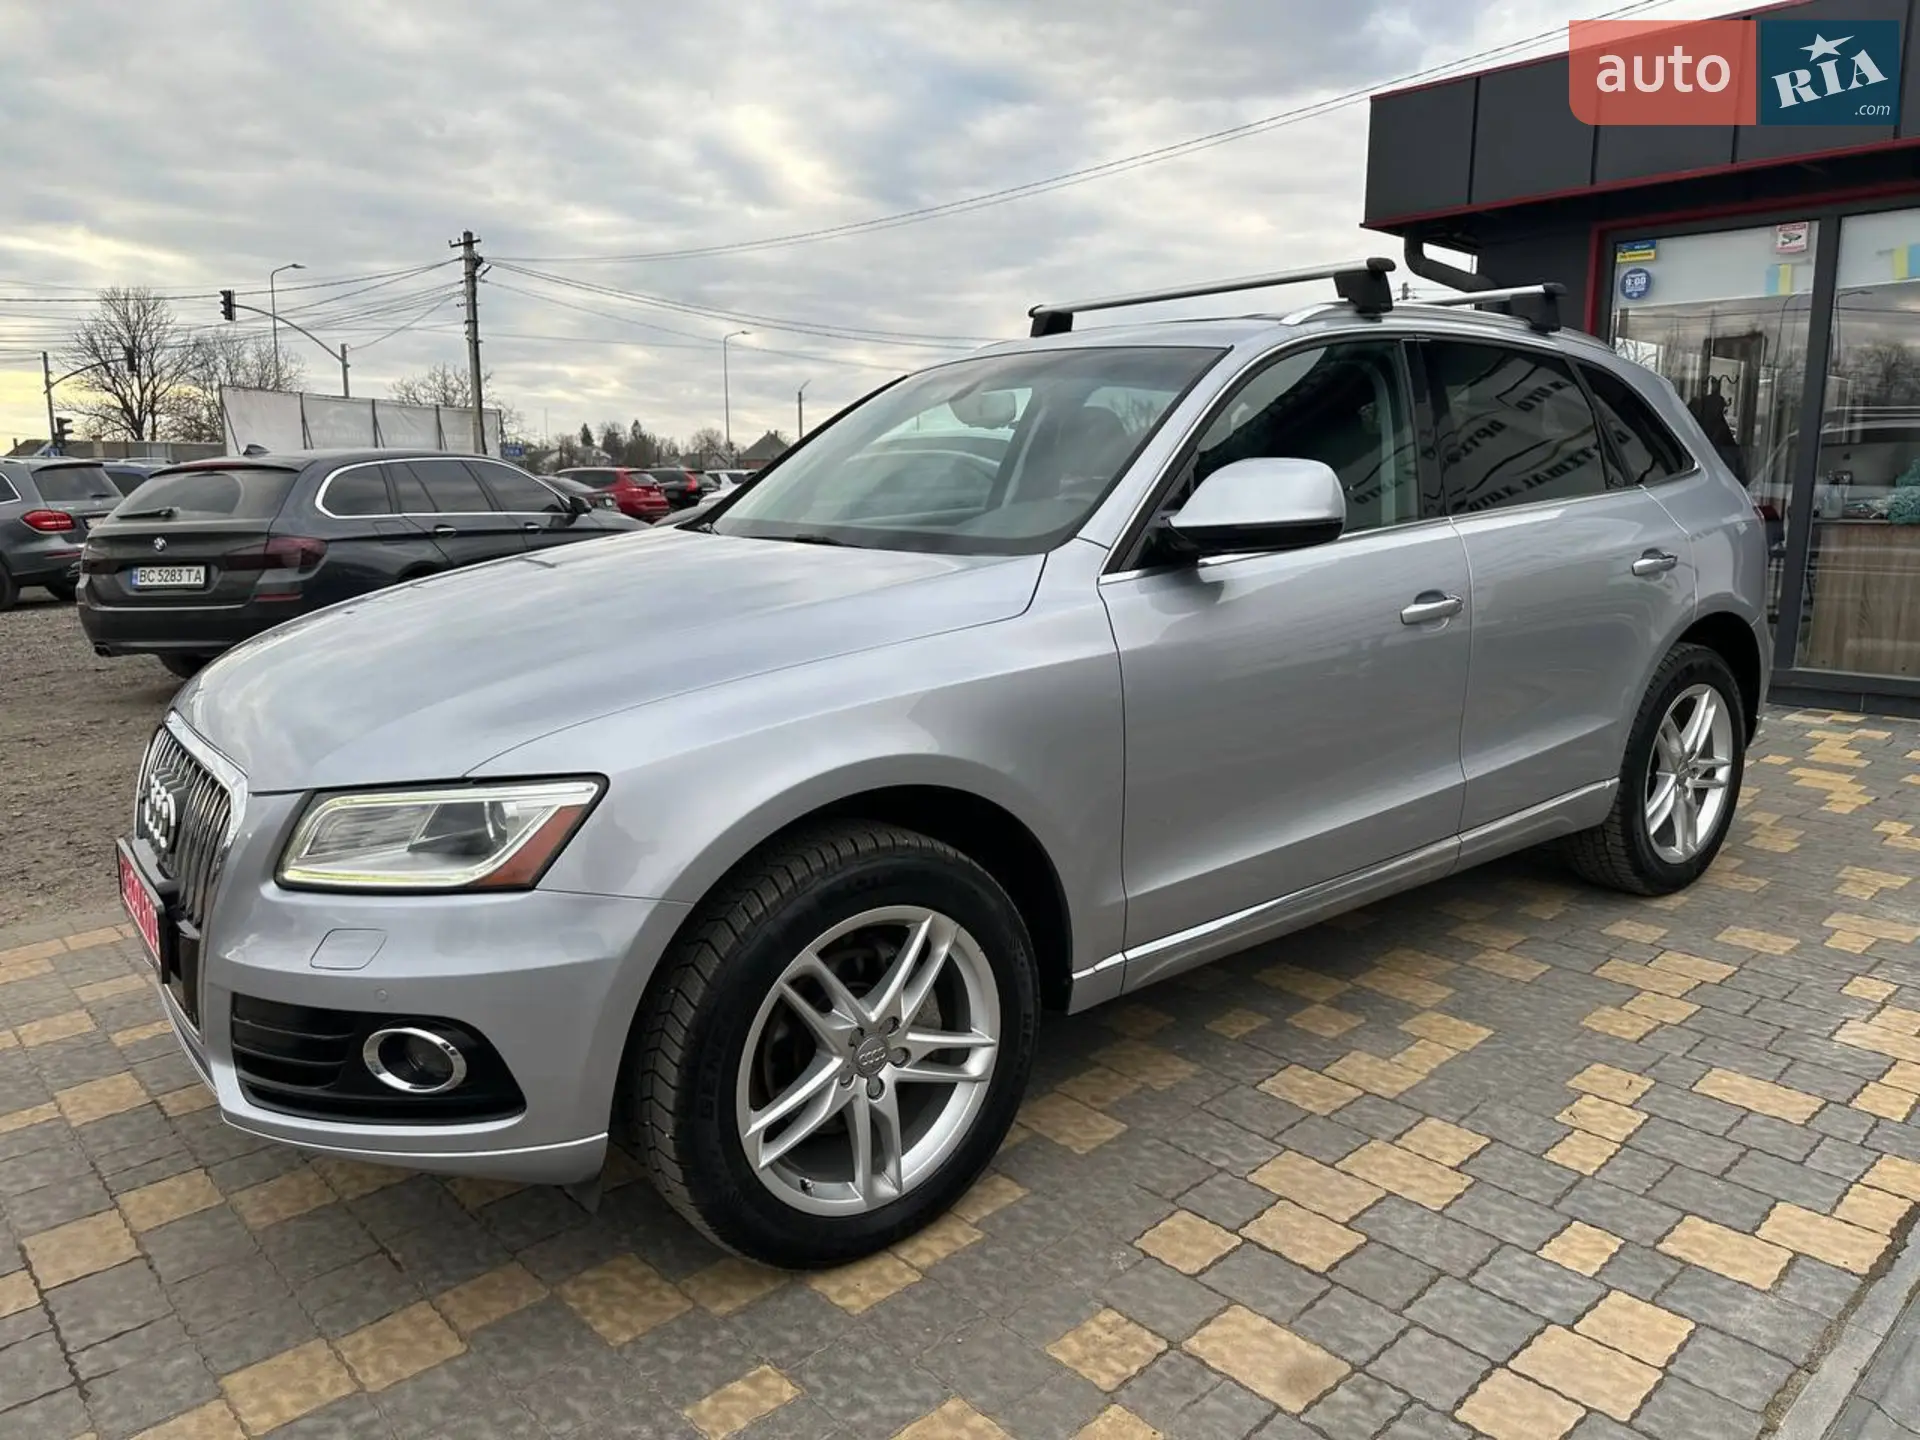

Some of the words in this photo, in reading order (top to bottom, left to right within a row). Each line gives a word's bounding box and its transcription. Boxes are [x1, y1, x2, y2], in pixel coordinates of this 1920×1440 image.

[139, 569, 155, 583] BC
[158, 568, 184, 583] 5283
[185, 568, 202, 583] TA
